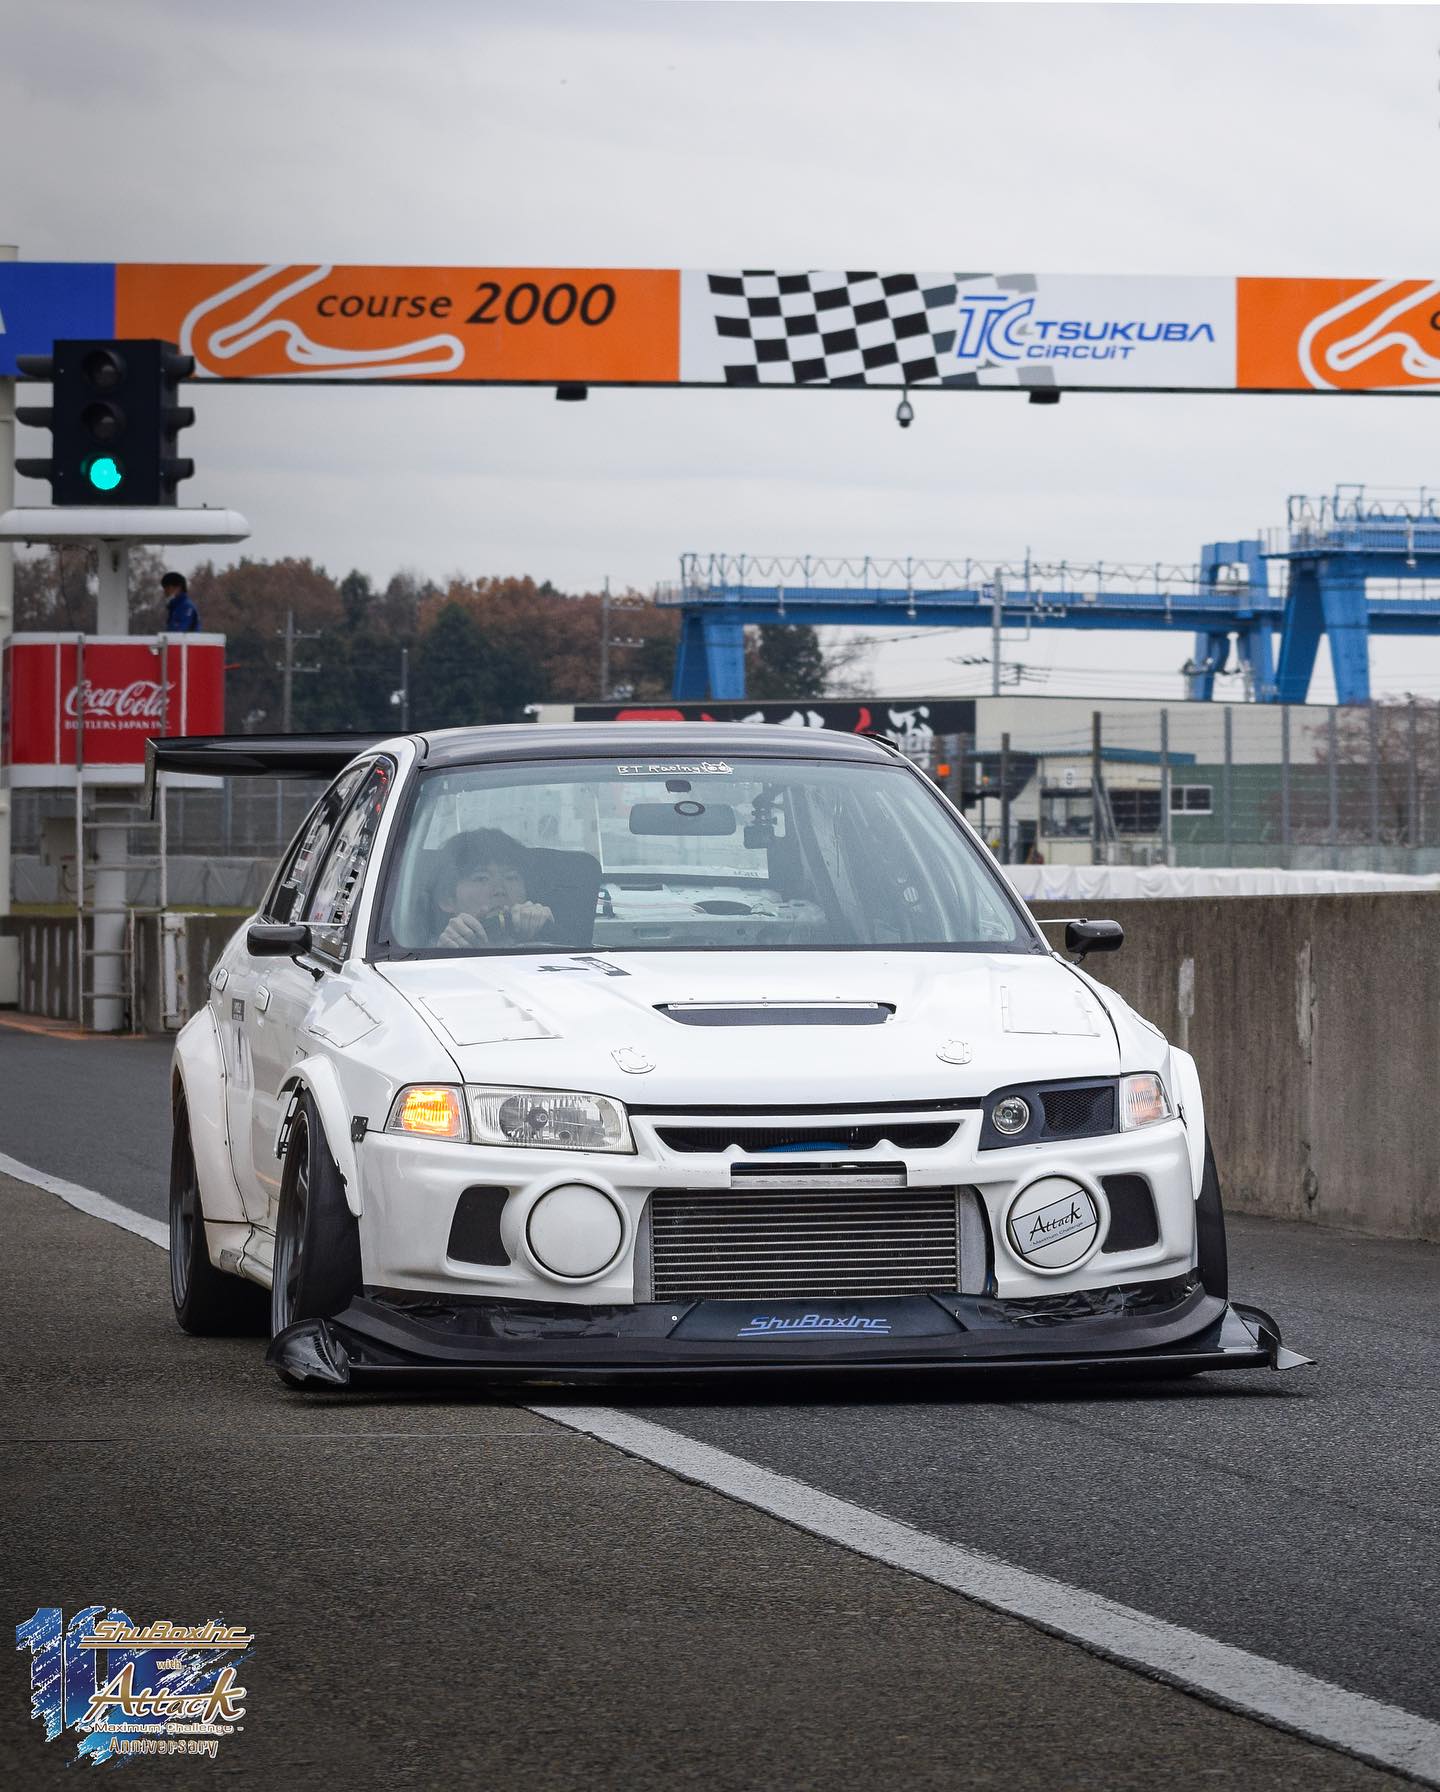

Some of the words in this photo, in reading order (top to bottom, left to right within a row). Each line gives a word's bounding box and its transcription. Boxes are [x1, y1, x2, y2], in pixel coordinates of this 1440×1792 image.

[316, 294, 453, 318] course
[465, 282, 616, 326] 2000
[957, 295, 1035, 360] TC
[1035, 321, 1215, 343] TSUKUBA
[64, 720, 117, 730] BOTLERS
[1029, 1201, 1083, 1242] Attack
